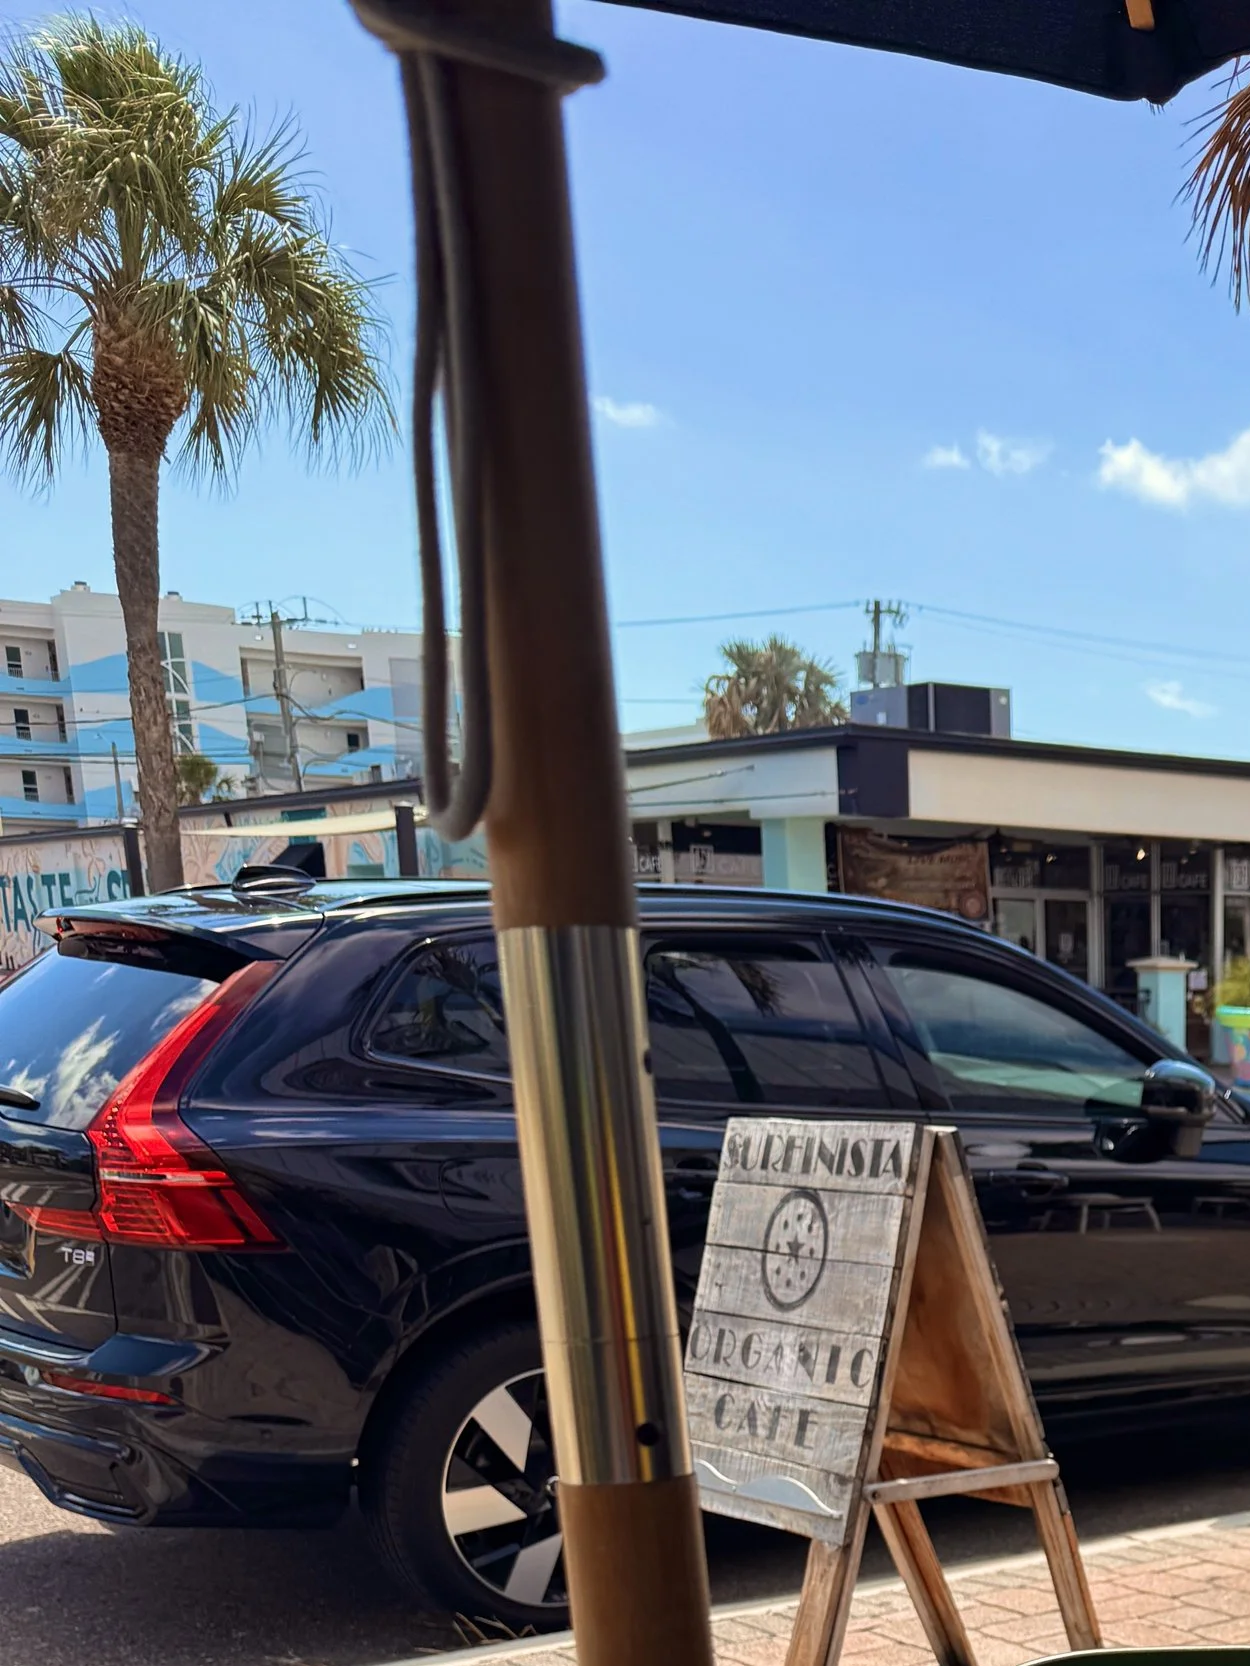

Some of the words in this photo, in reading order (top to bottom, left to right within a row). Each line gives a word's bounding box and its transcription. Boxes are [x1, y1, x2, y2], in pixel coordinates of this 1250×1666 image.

[723, 1131, 902, 1179] SURFINISTA
[689, 1324, 875, 1389] ORGANIC
[714, 1393, 819, 1450] CAFE
